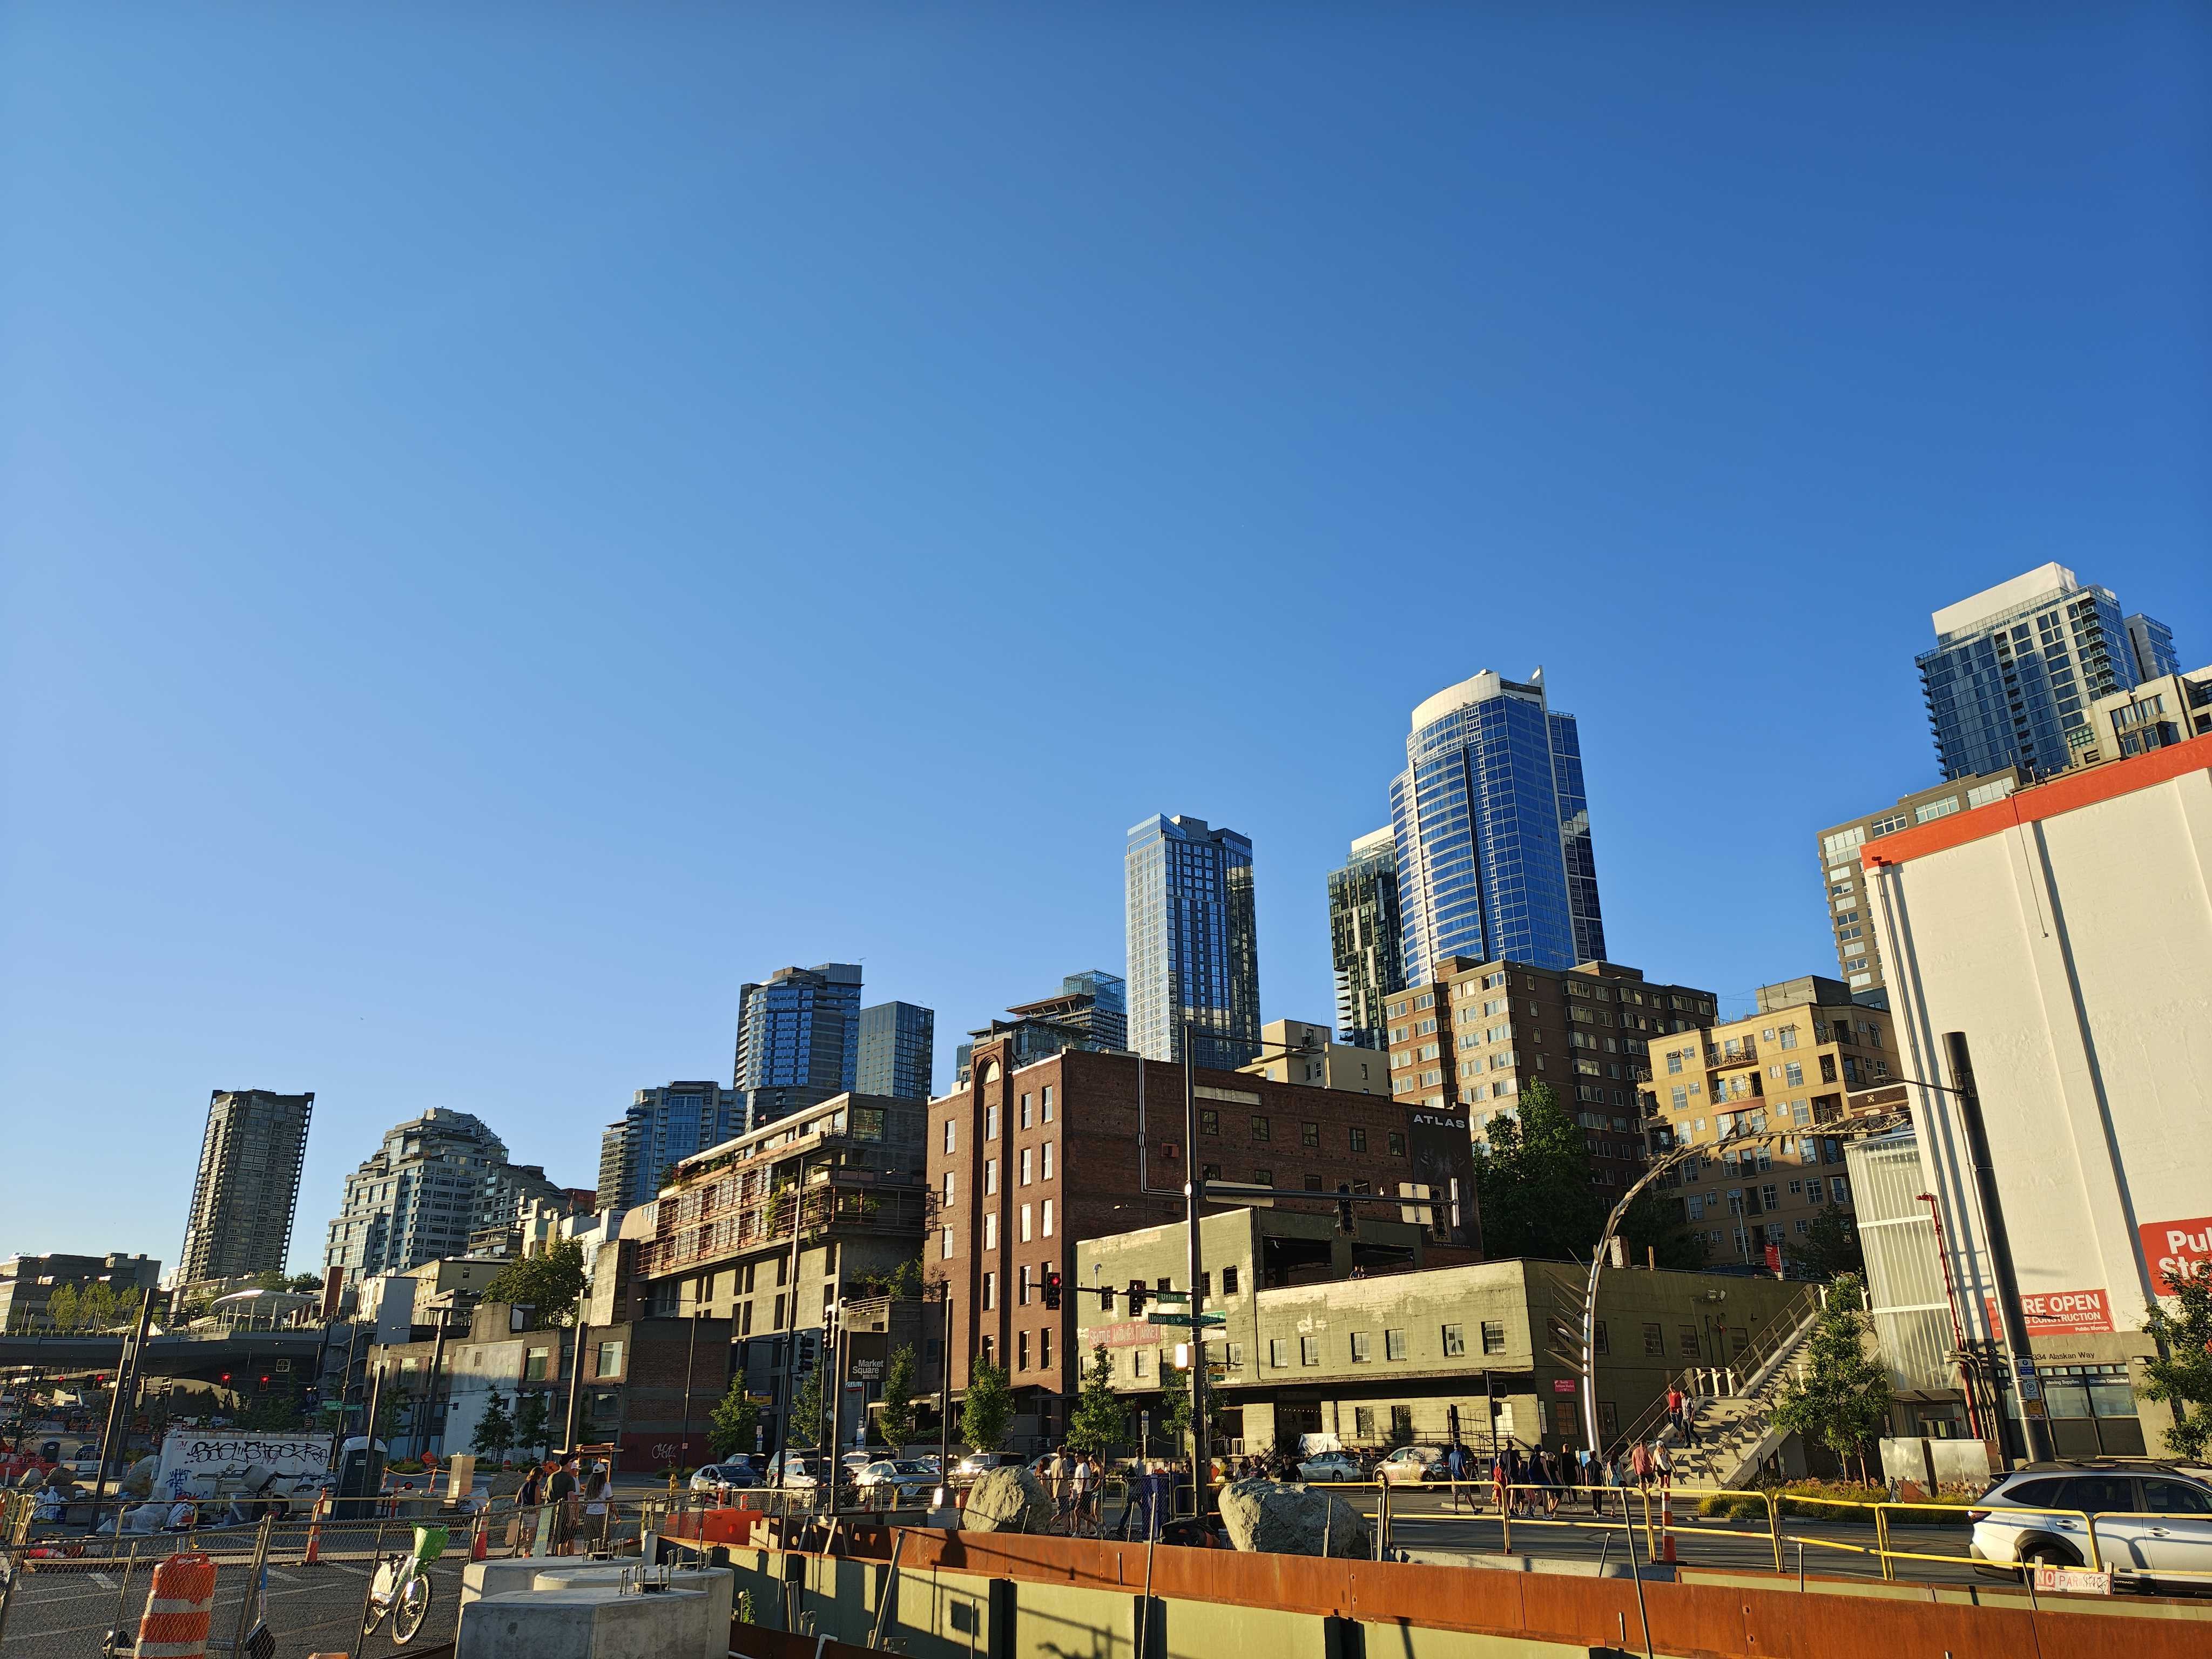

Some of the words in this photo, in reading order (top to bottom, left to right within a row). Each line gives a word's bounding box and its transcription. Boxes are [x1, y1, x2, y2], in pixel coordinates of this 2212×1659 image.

[1413, 1114, 1465, 1129] ATLAS
[2159, 1256, 2212, 1280] Sto
[2050, 1293, 2101, 1312] OPEN
[1149, 1314, 1166, 1323] Union
[2033, 1312, 2101, 1324] CONSTRUCTION
[858, 1359, 884, 1368] Market
[852, 1366, 880, 1375] Square
[2035, 1570, 2055, 1586] NO
